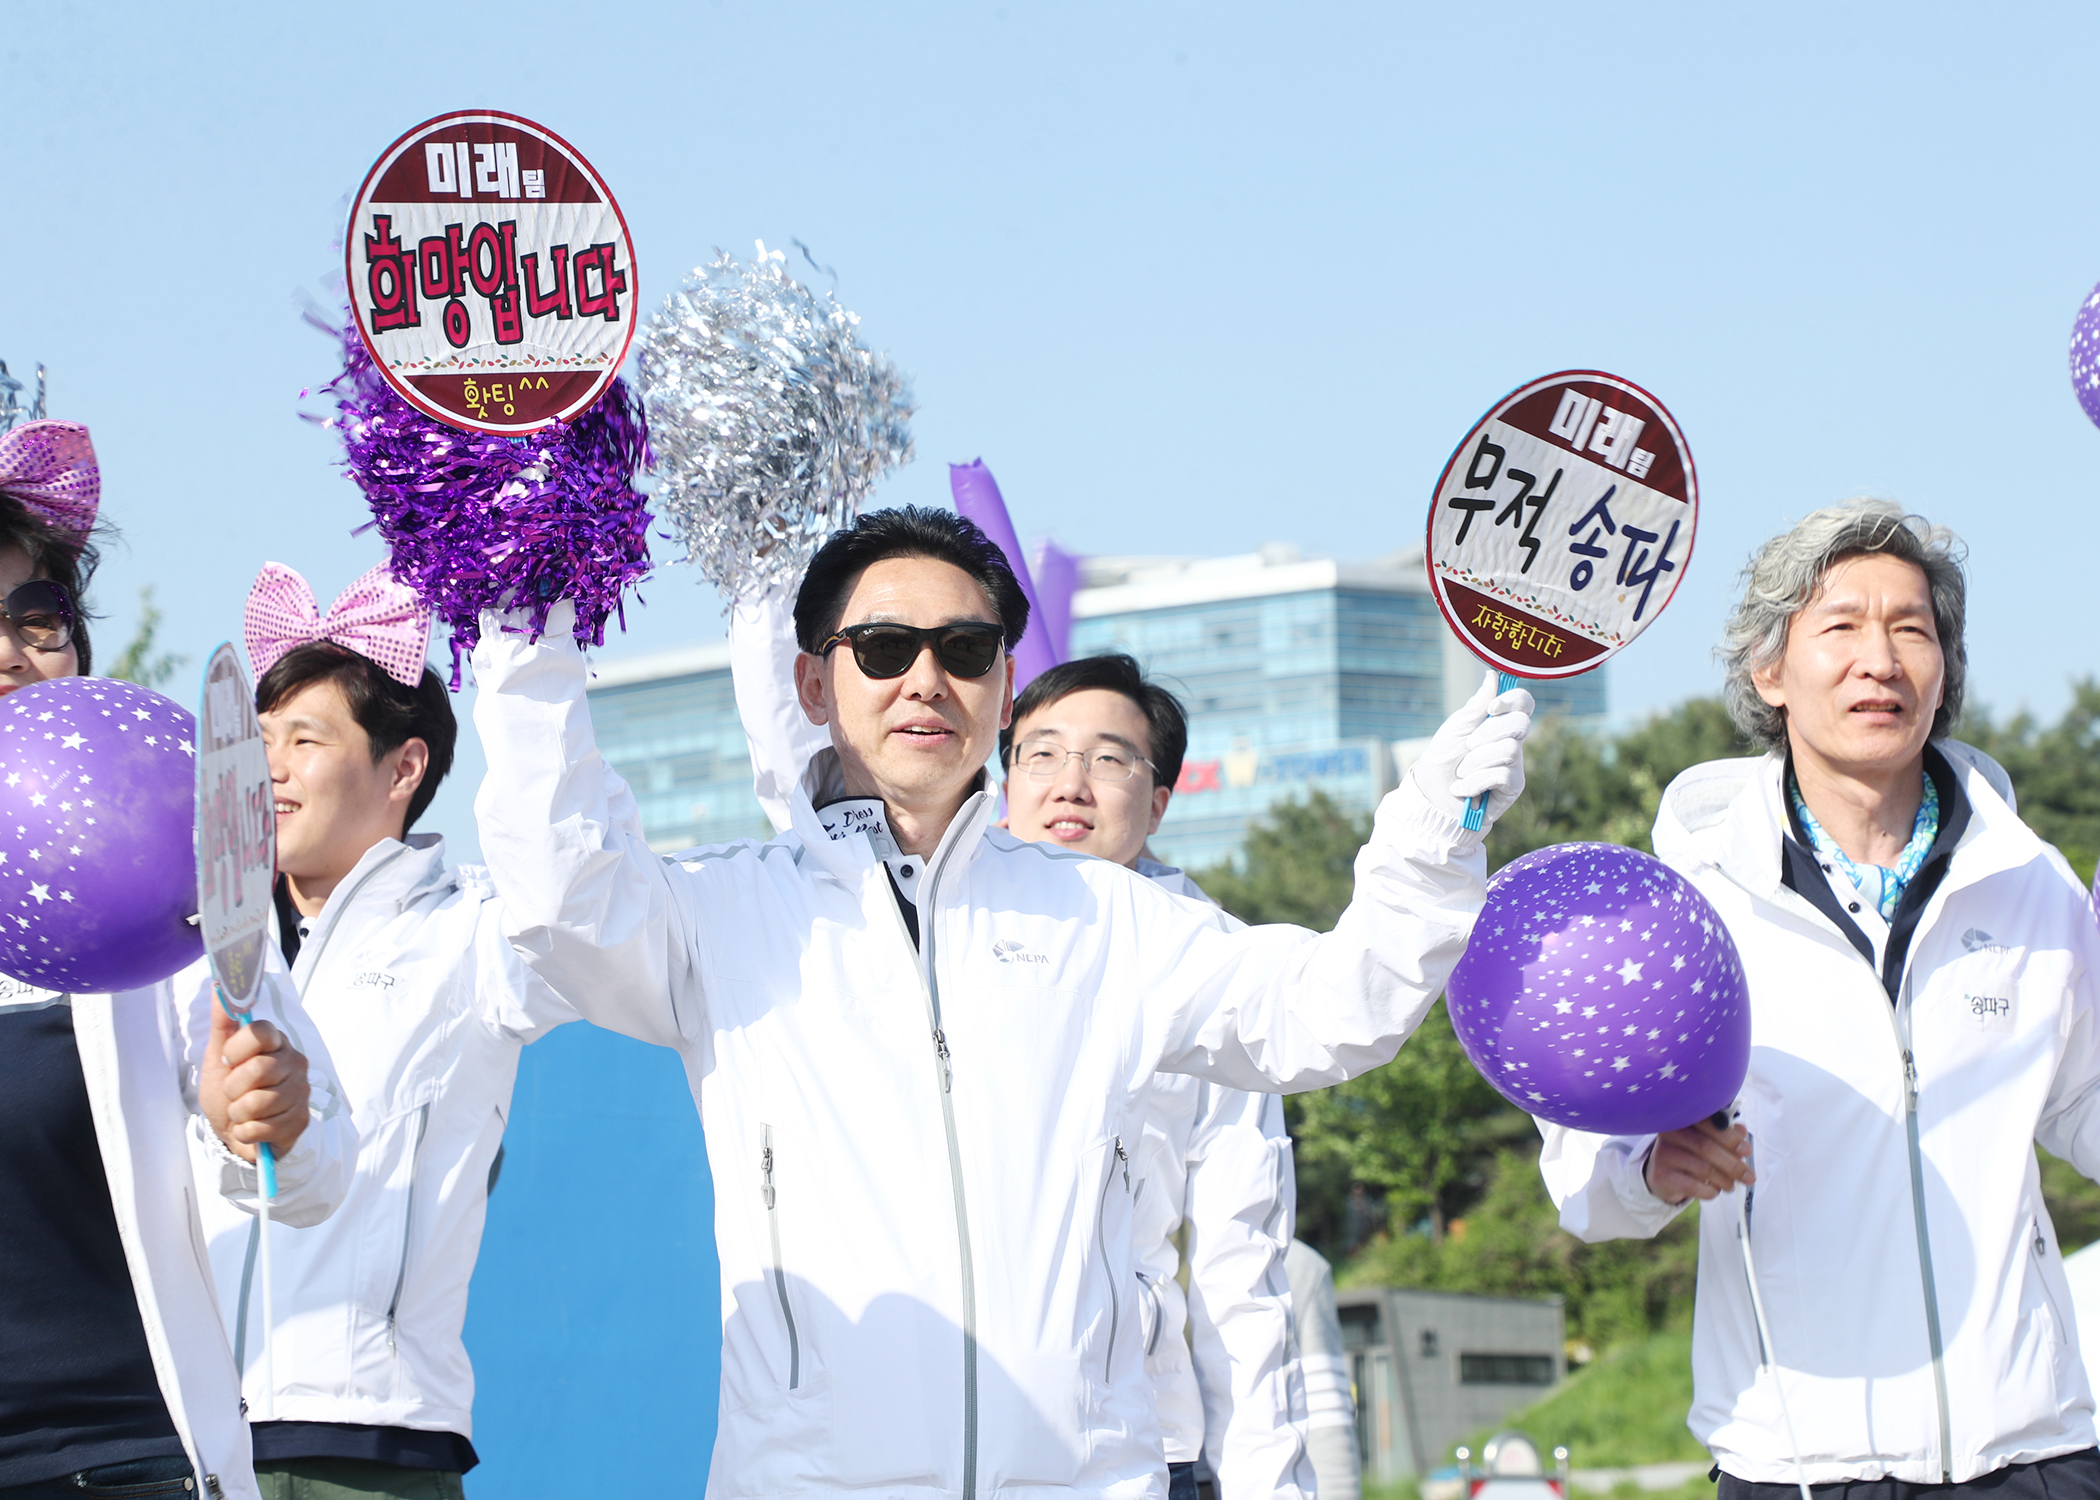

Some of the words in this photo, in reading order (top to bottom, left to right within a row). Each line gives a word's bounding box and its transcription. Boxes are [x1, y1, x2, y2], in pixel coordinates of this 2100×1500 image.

[364, 214, 627, 348] 희망입니다
[464, 377, 515, 419] 홧팅
[1448, 433, 1563, 574] 무적
[1568, 484, 1680, 622] 송파
[1471, 605, 1565, 657] 사랑합니다
[1016, 953, 1050, 964] NEPA
[0, 980, 48, 999] 송파
[1971, 996, 2010, 1017] 송파구
